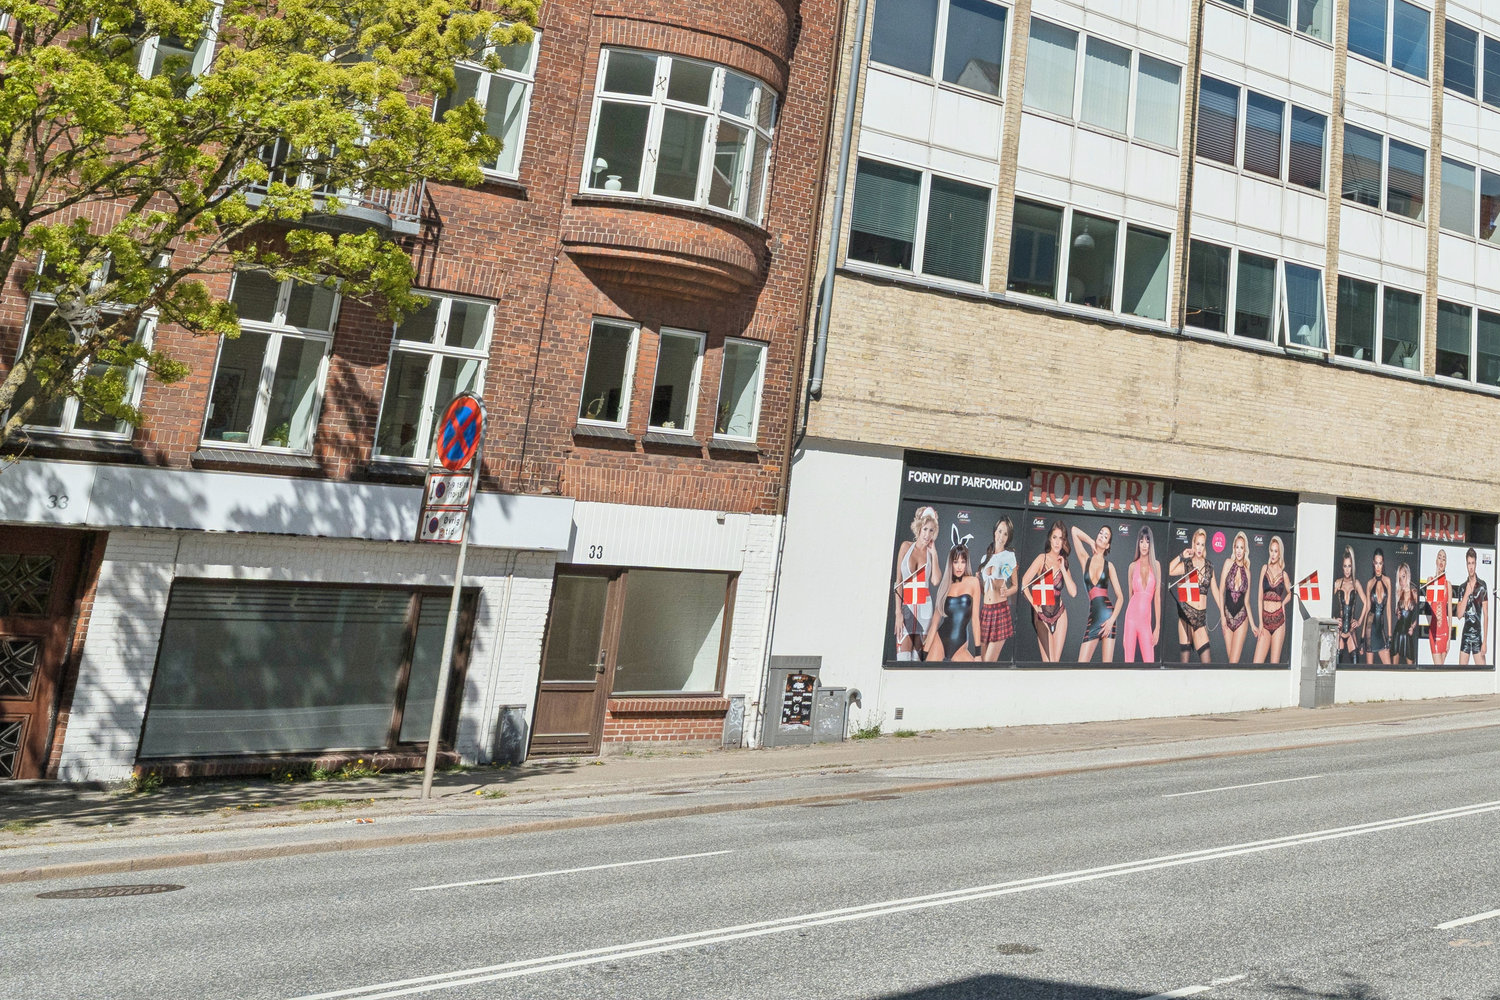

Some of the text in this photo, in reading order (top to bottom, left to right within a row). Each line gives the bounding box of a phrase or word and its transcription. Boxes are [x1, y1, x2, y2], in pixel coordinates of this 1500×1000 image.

[908, 470, 1023, 492] FORNY DIT PARFORHOLD
[1029, 470, 1162, 514] HOTGIRL
[47, 495, 69, 509] 33
[1191, 498, 1279, 515] FORNY DIT PARFORHOLD
[444, 516, 460, 526] Øvrig
[589, 545, 603, 559] 33
